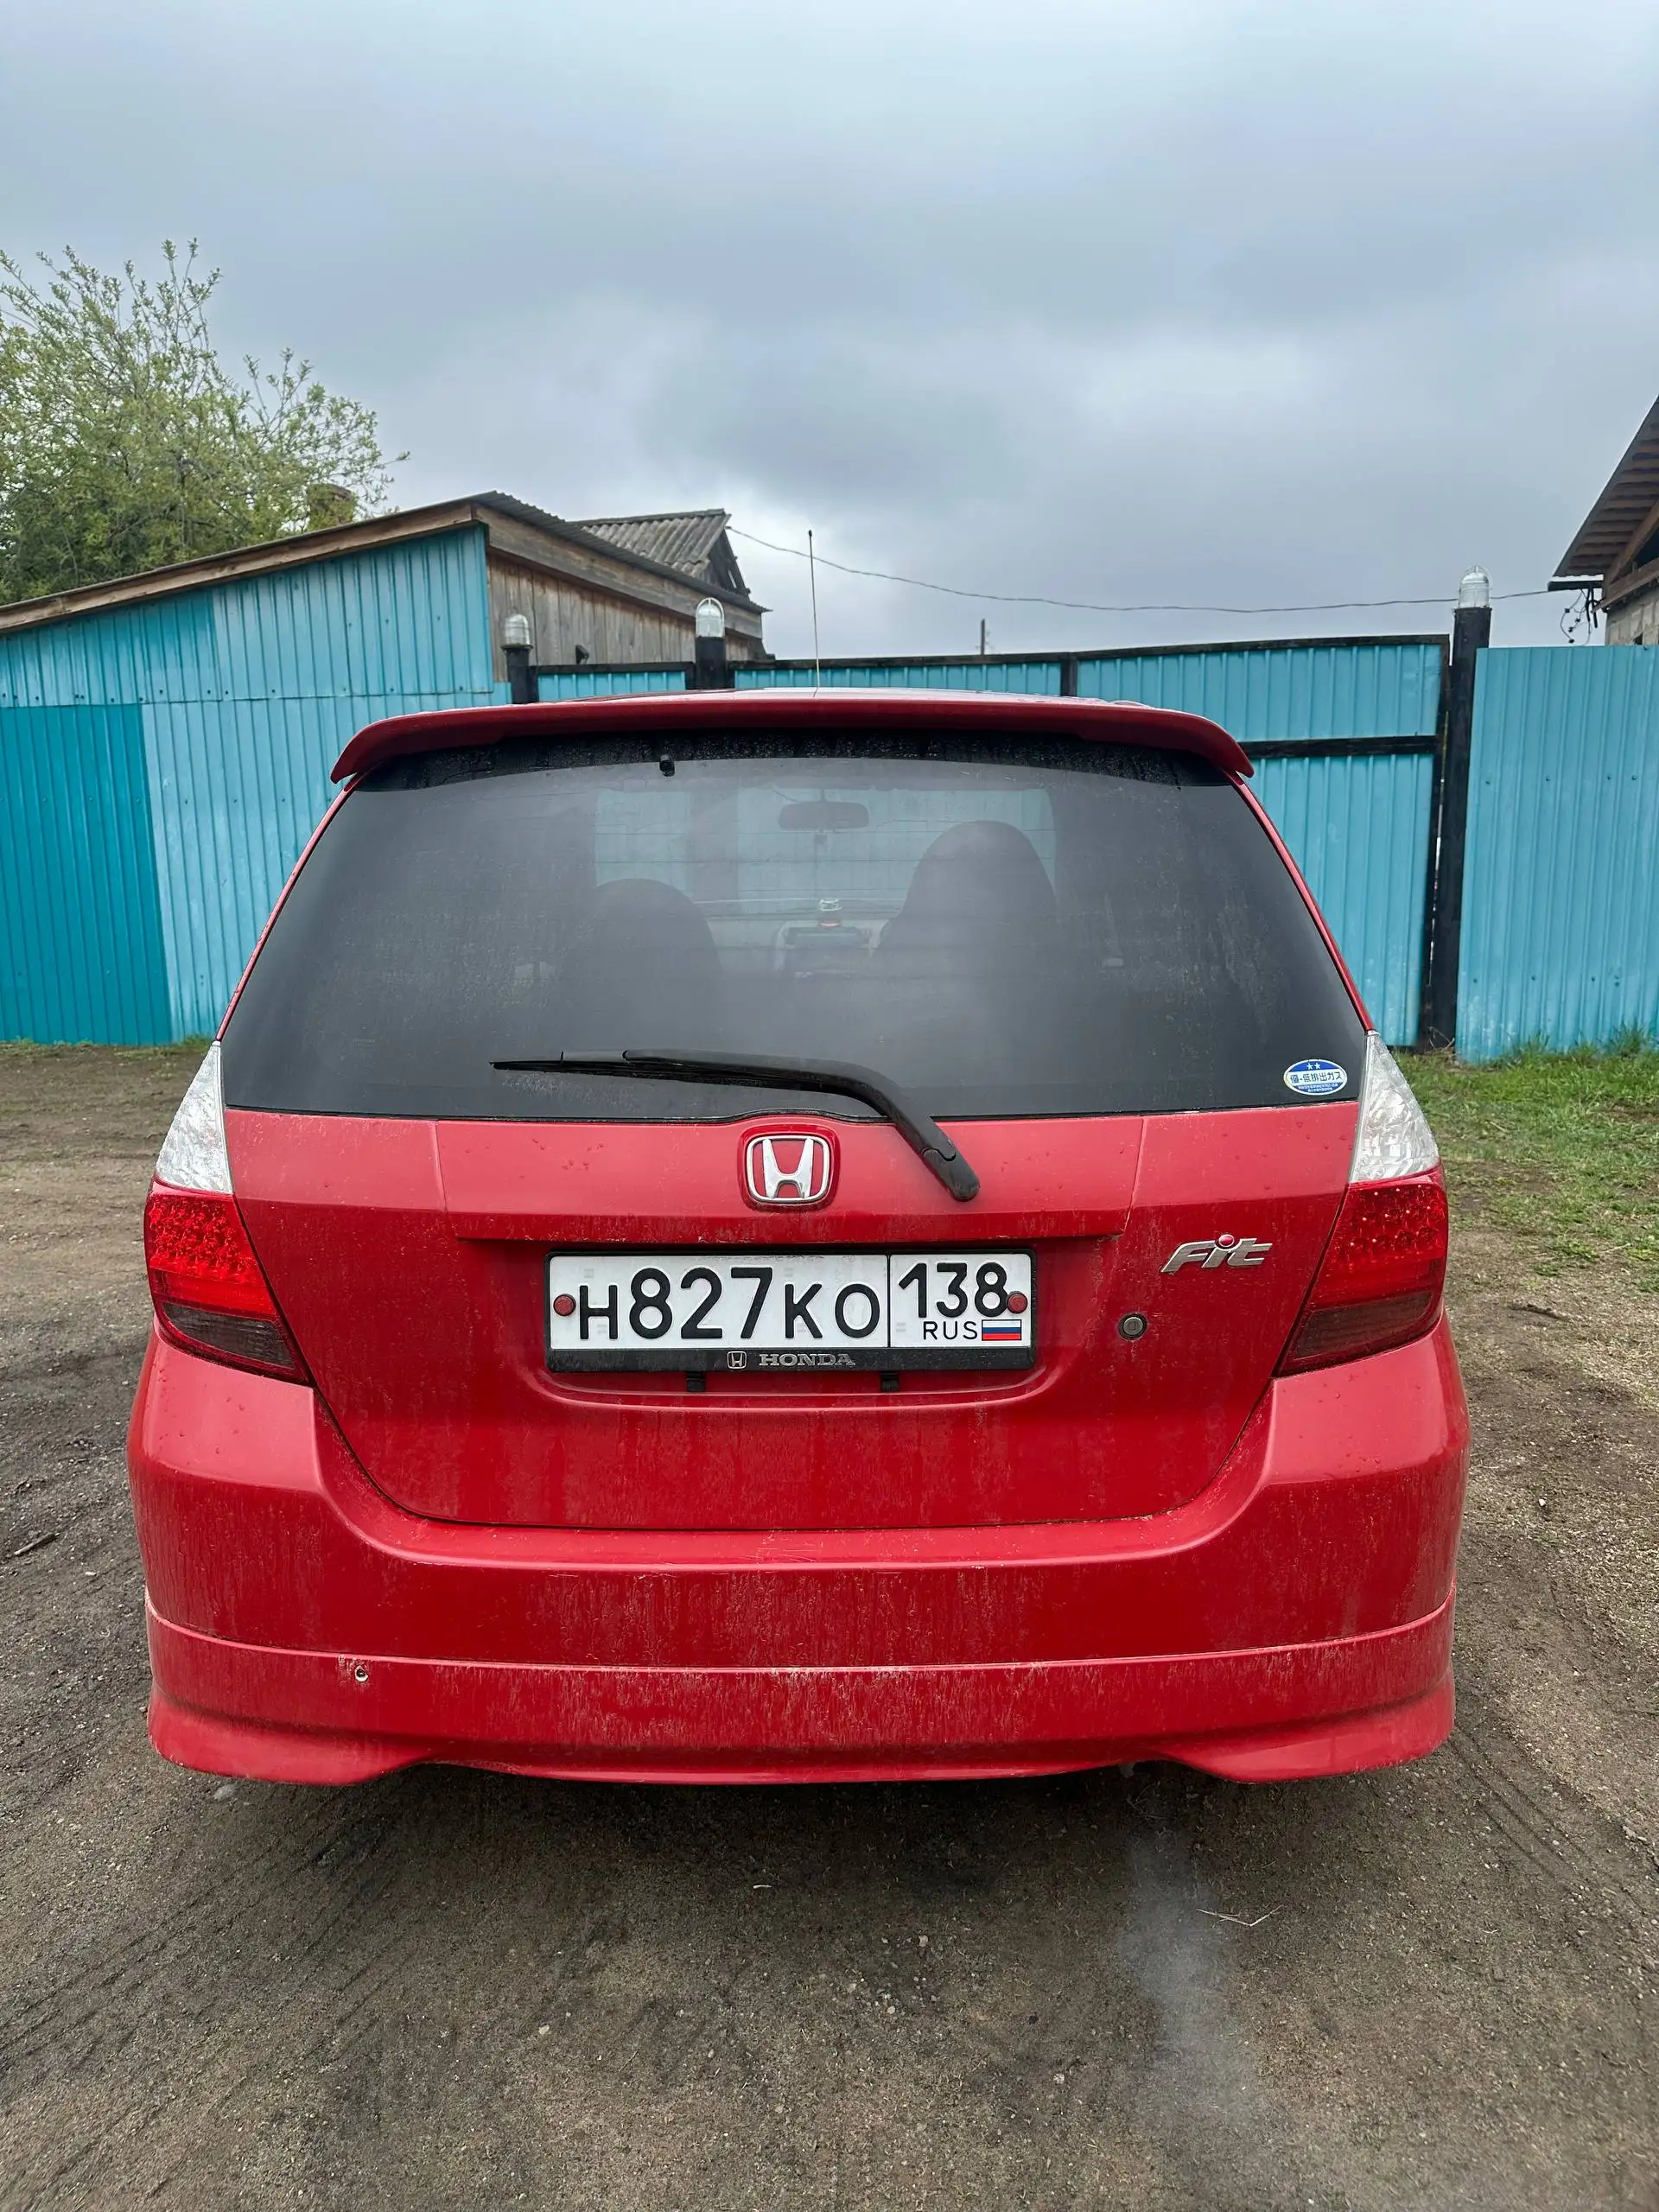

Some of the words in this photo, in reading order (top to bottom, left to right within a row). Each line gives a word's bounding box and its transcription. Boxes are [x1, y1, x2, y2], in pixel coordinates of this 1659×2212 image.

[1160, 1234, 1273, 1274] Fit
[898, 1262, 1008, 1319] 138
[923, 1321, 978, 1340] RUS
[759, 1353, 856, 1366] HONDA
